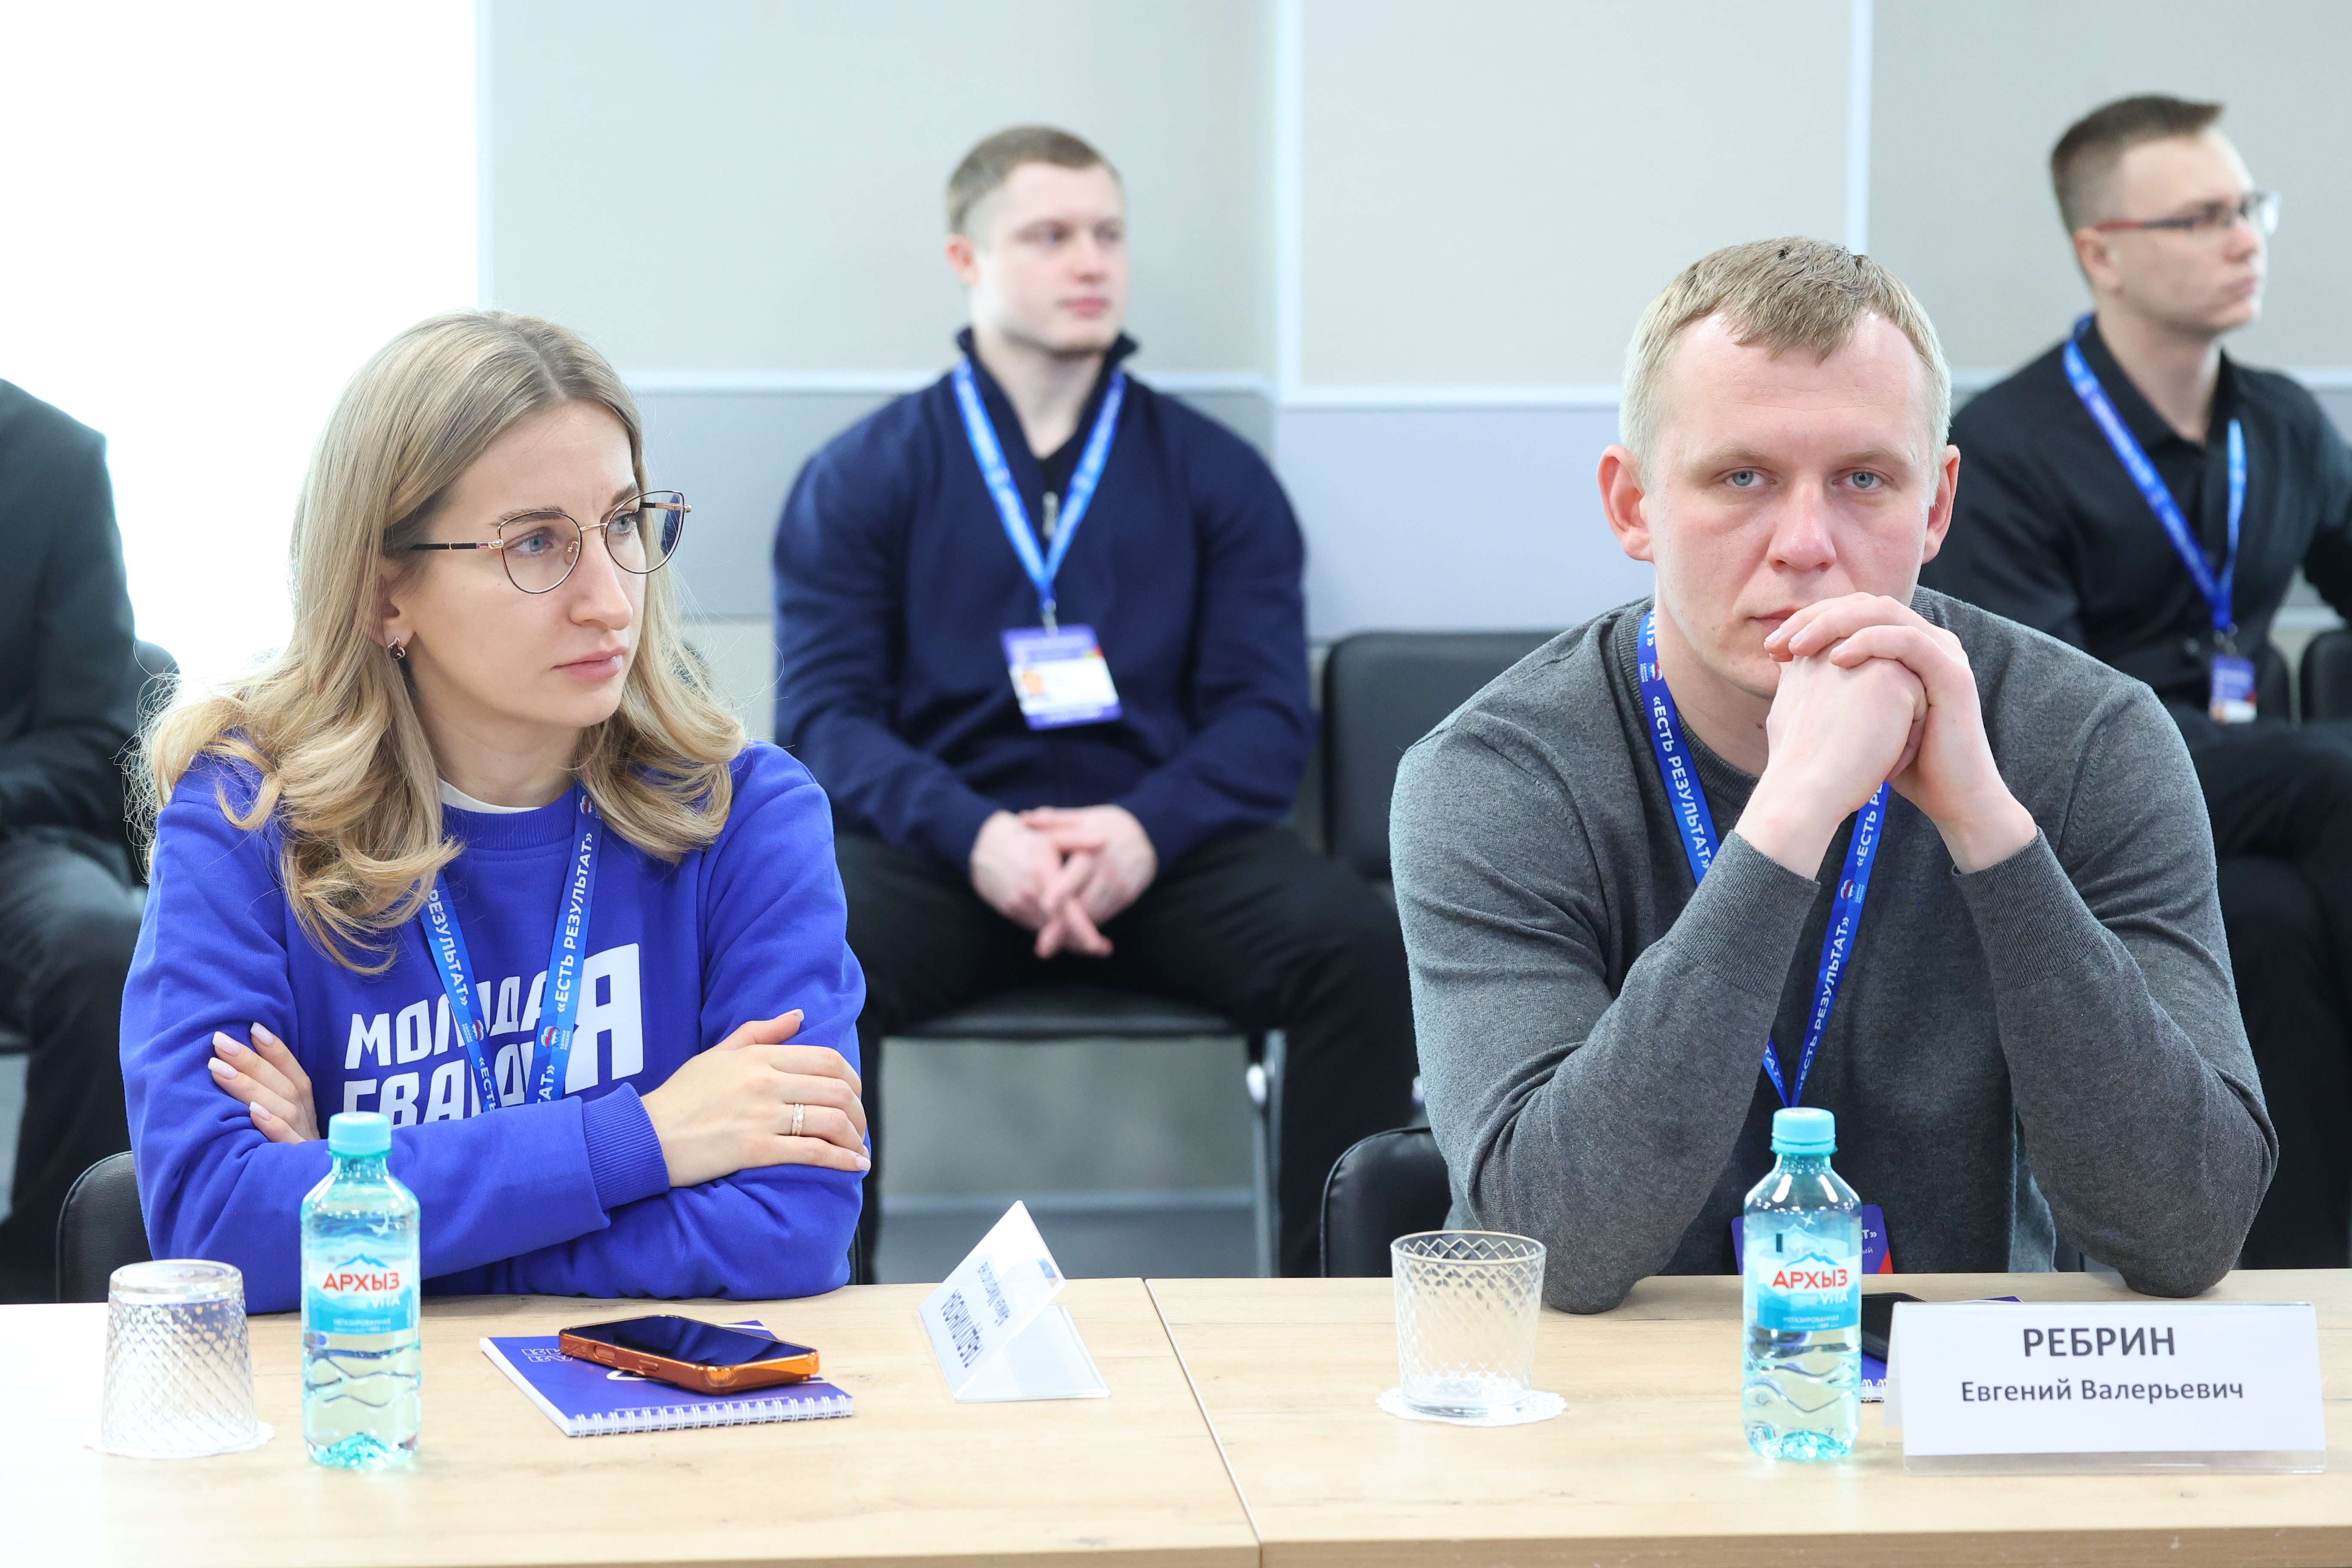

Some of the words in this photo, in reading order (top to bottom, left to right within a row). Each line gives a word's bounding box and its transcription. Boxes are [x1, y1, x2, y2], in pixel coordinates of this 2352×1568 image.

[1653, 695, 1675, 753] «ЕСТЬ
[1667, 755, 1712, 869] РЕЗУЛЬТАТ»
[1856, 810, 1877, 867] «ЕСТЬ
[564, 832, 593, 950] РЕЗУЛЬТАТ»
[554, 954, 575, 1013] «ЕСТЬ
[1814, 916, 1850, 1031] РЕЗУЛЬТАТ»
[323, 1272, 400, 1292] АРХЫЗ
[1772, 1268, 1848, 1289] АРХЫЗ
[2023, 1326, 2175, 1357] РЕБРИН
[1962, 1378, 2071, 1402] Евгений
[2081, 1379, 2243, 1405] Валерьевич
